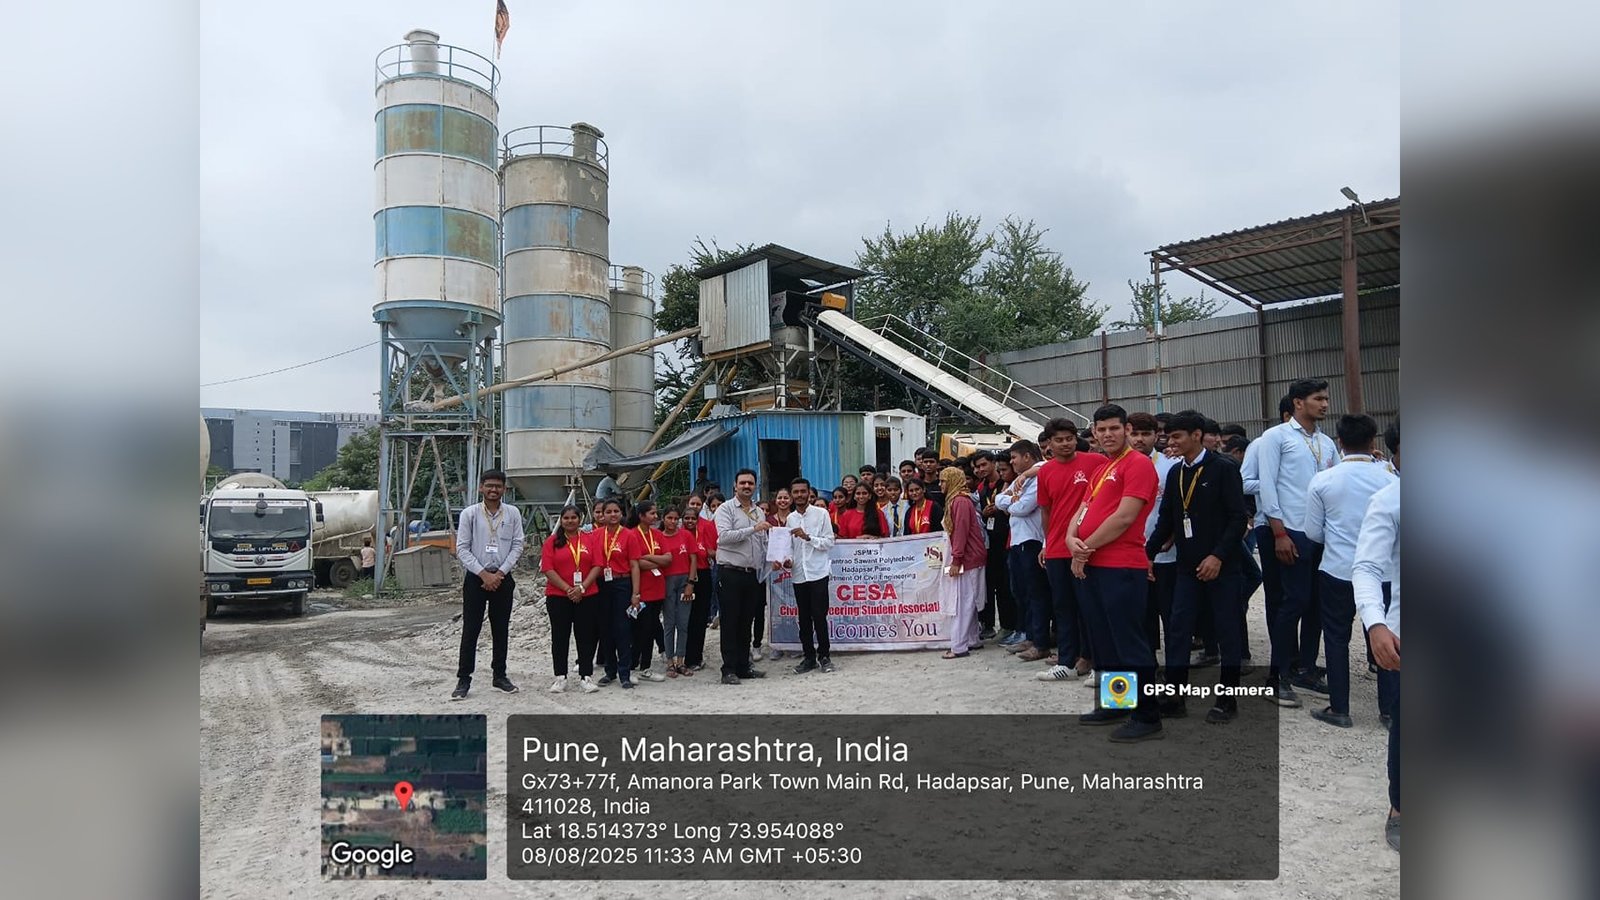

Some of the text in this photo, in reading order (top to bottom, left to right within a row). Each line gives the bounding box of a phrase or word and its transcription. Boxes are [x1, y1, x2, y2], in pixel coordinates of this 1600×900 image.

[879, 555, 915, 564] Polytechnic
[924, 546, 943, 561] JS
[836, 583, 898, 601] CESA
[780, 605, 798, 616] Civi
[828, 605, 860, 617] eering
[861, 604, 896, 615] Student
[898, 601, 940, 614] Associati
[829, 619, 938, 639] lcomes You
